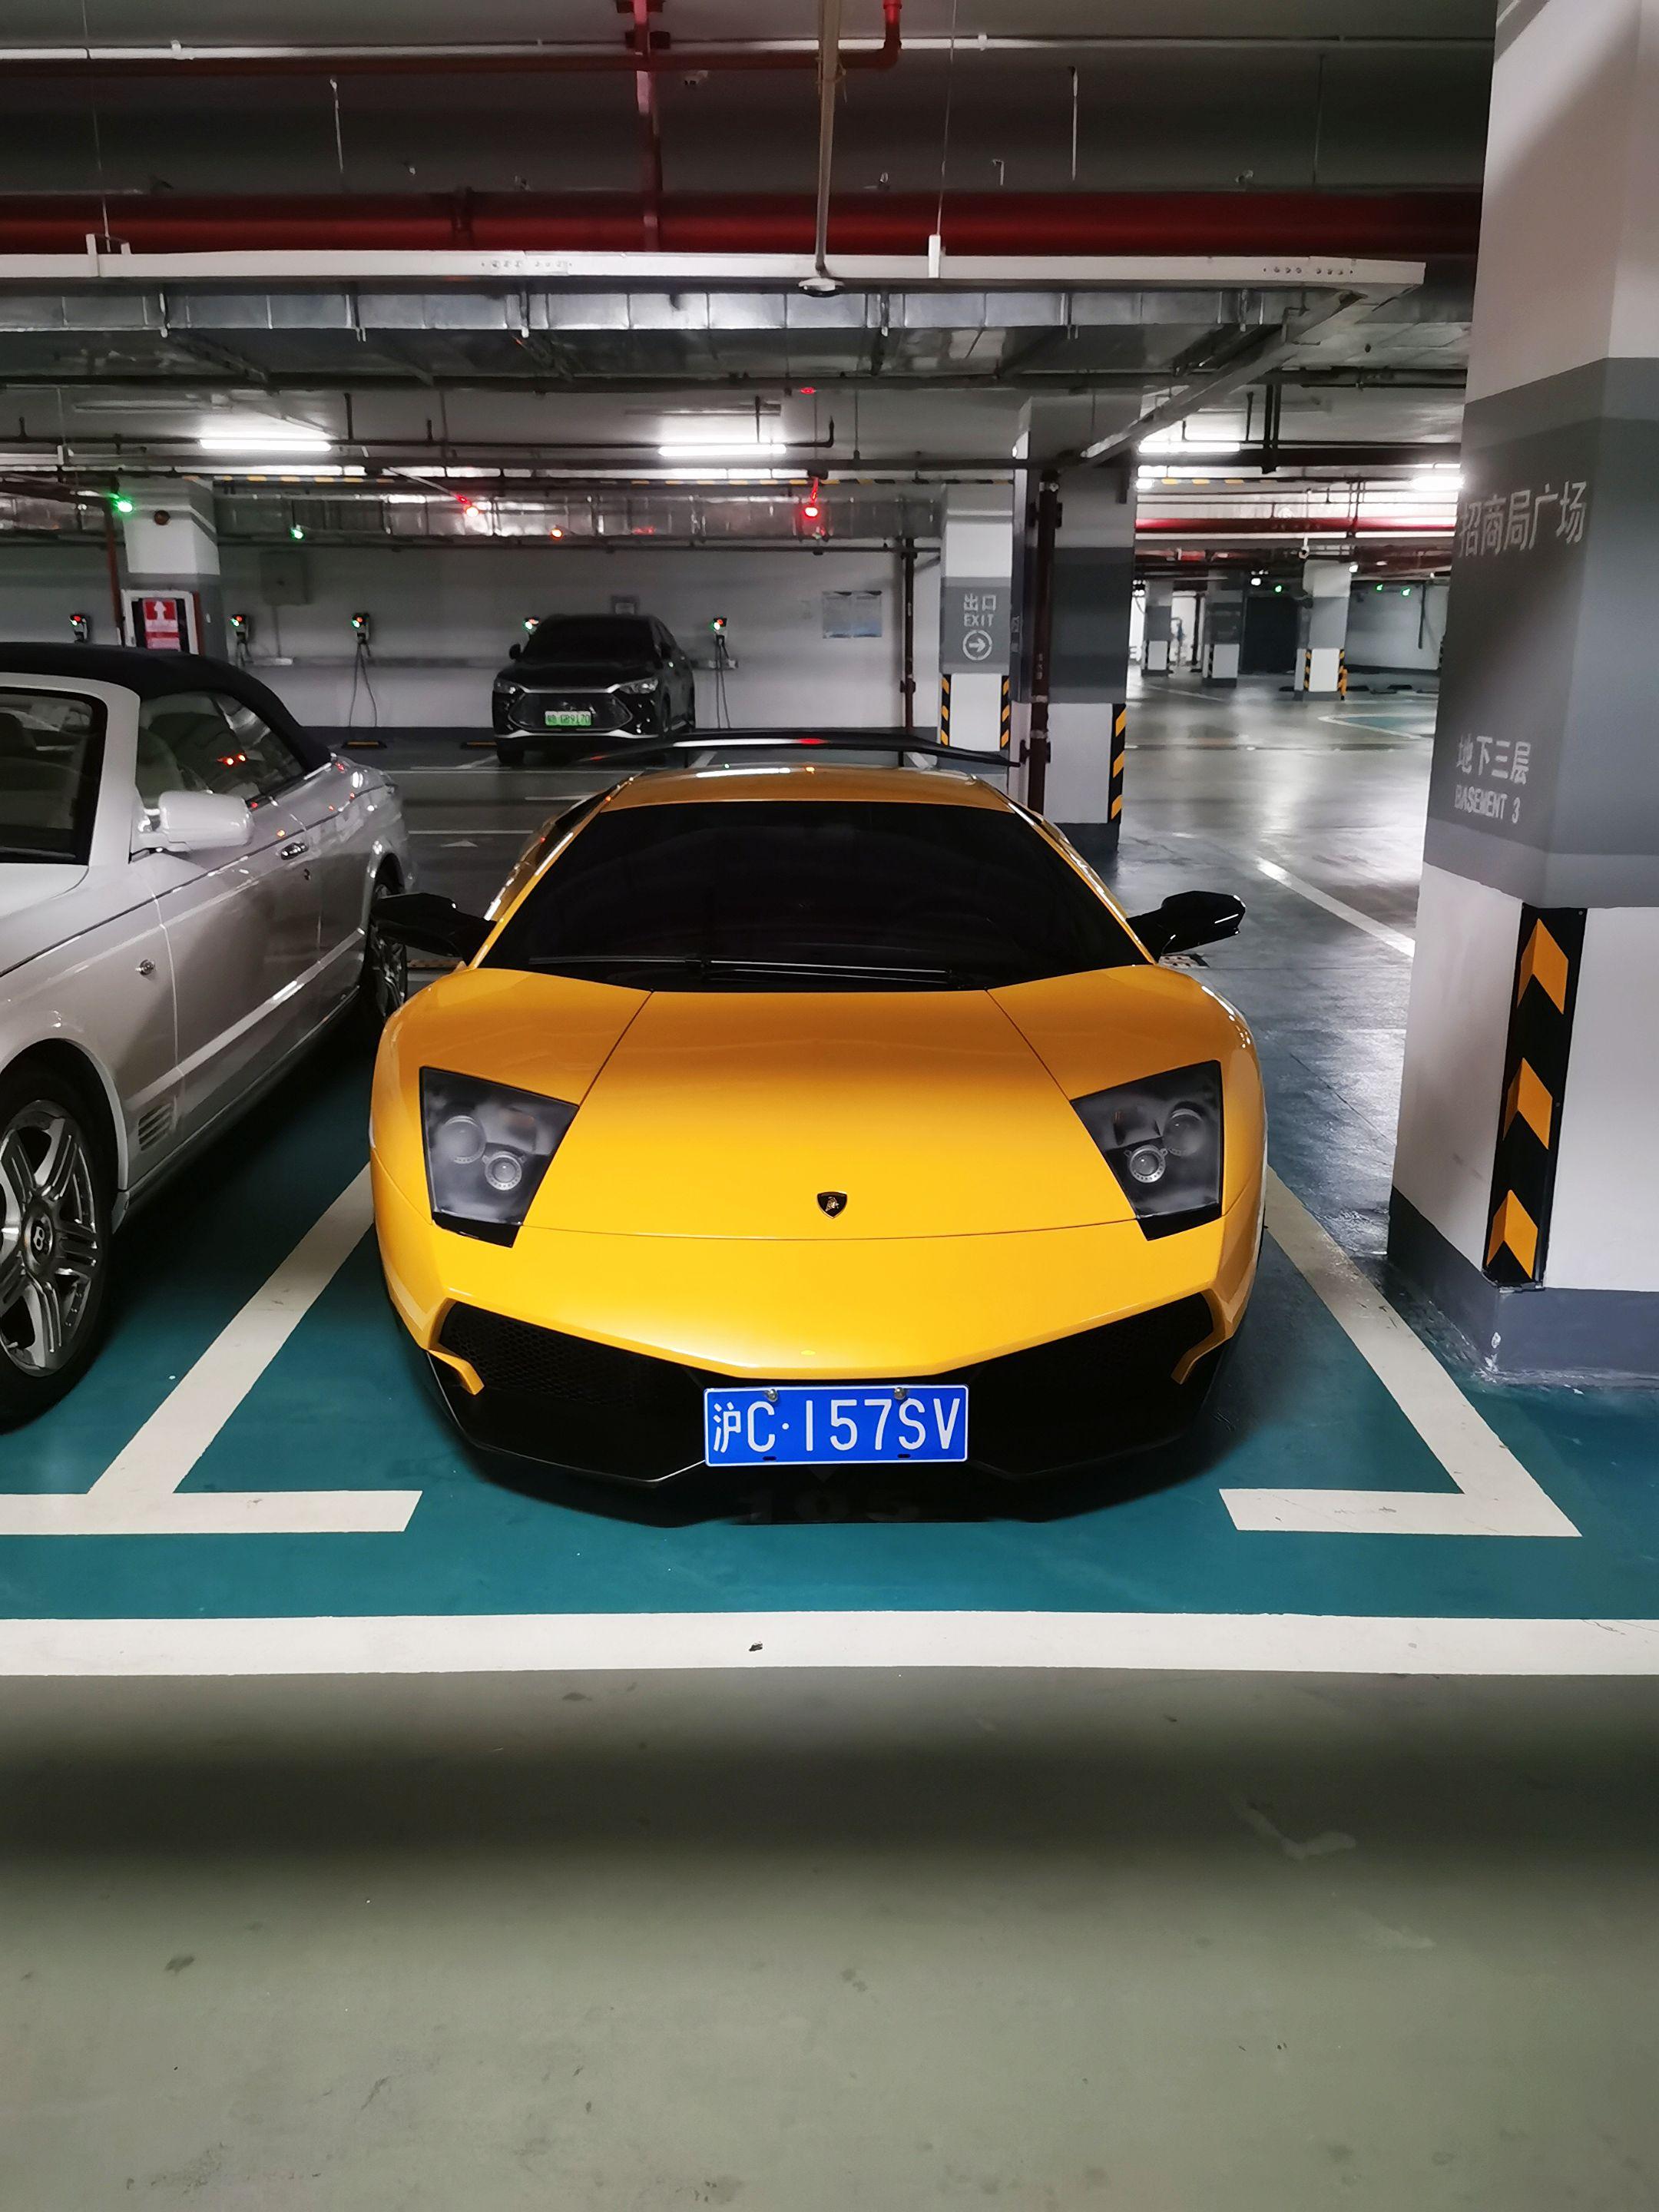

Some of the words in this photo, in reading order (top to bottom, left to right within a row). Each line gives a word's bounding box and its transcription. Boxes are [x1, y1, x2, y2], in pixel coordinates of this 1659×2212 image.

[1459, 481, 1588, 558] 招商局广场
[963, 593, 997, 611] 出口
[964, 614, 995, 628] EXIT
[1456, 733, 1531, 784] 地下三层
[1455, 784, 1508, 820] BASEMENT
[1512, 796, 1521, 823] 3
